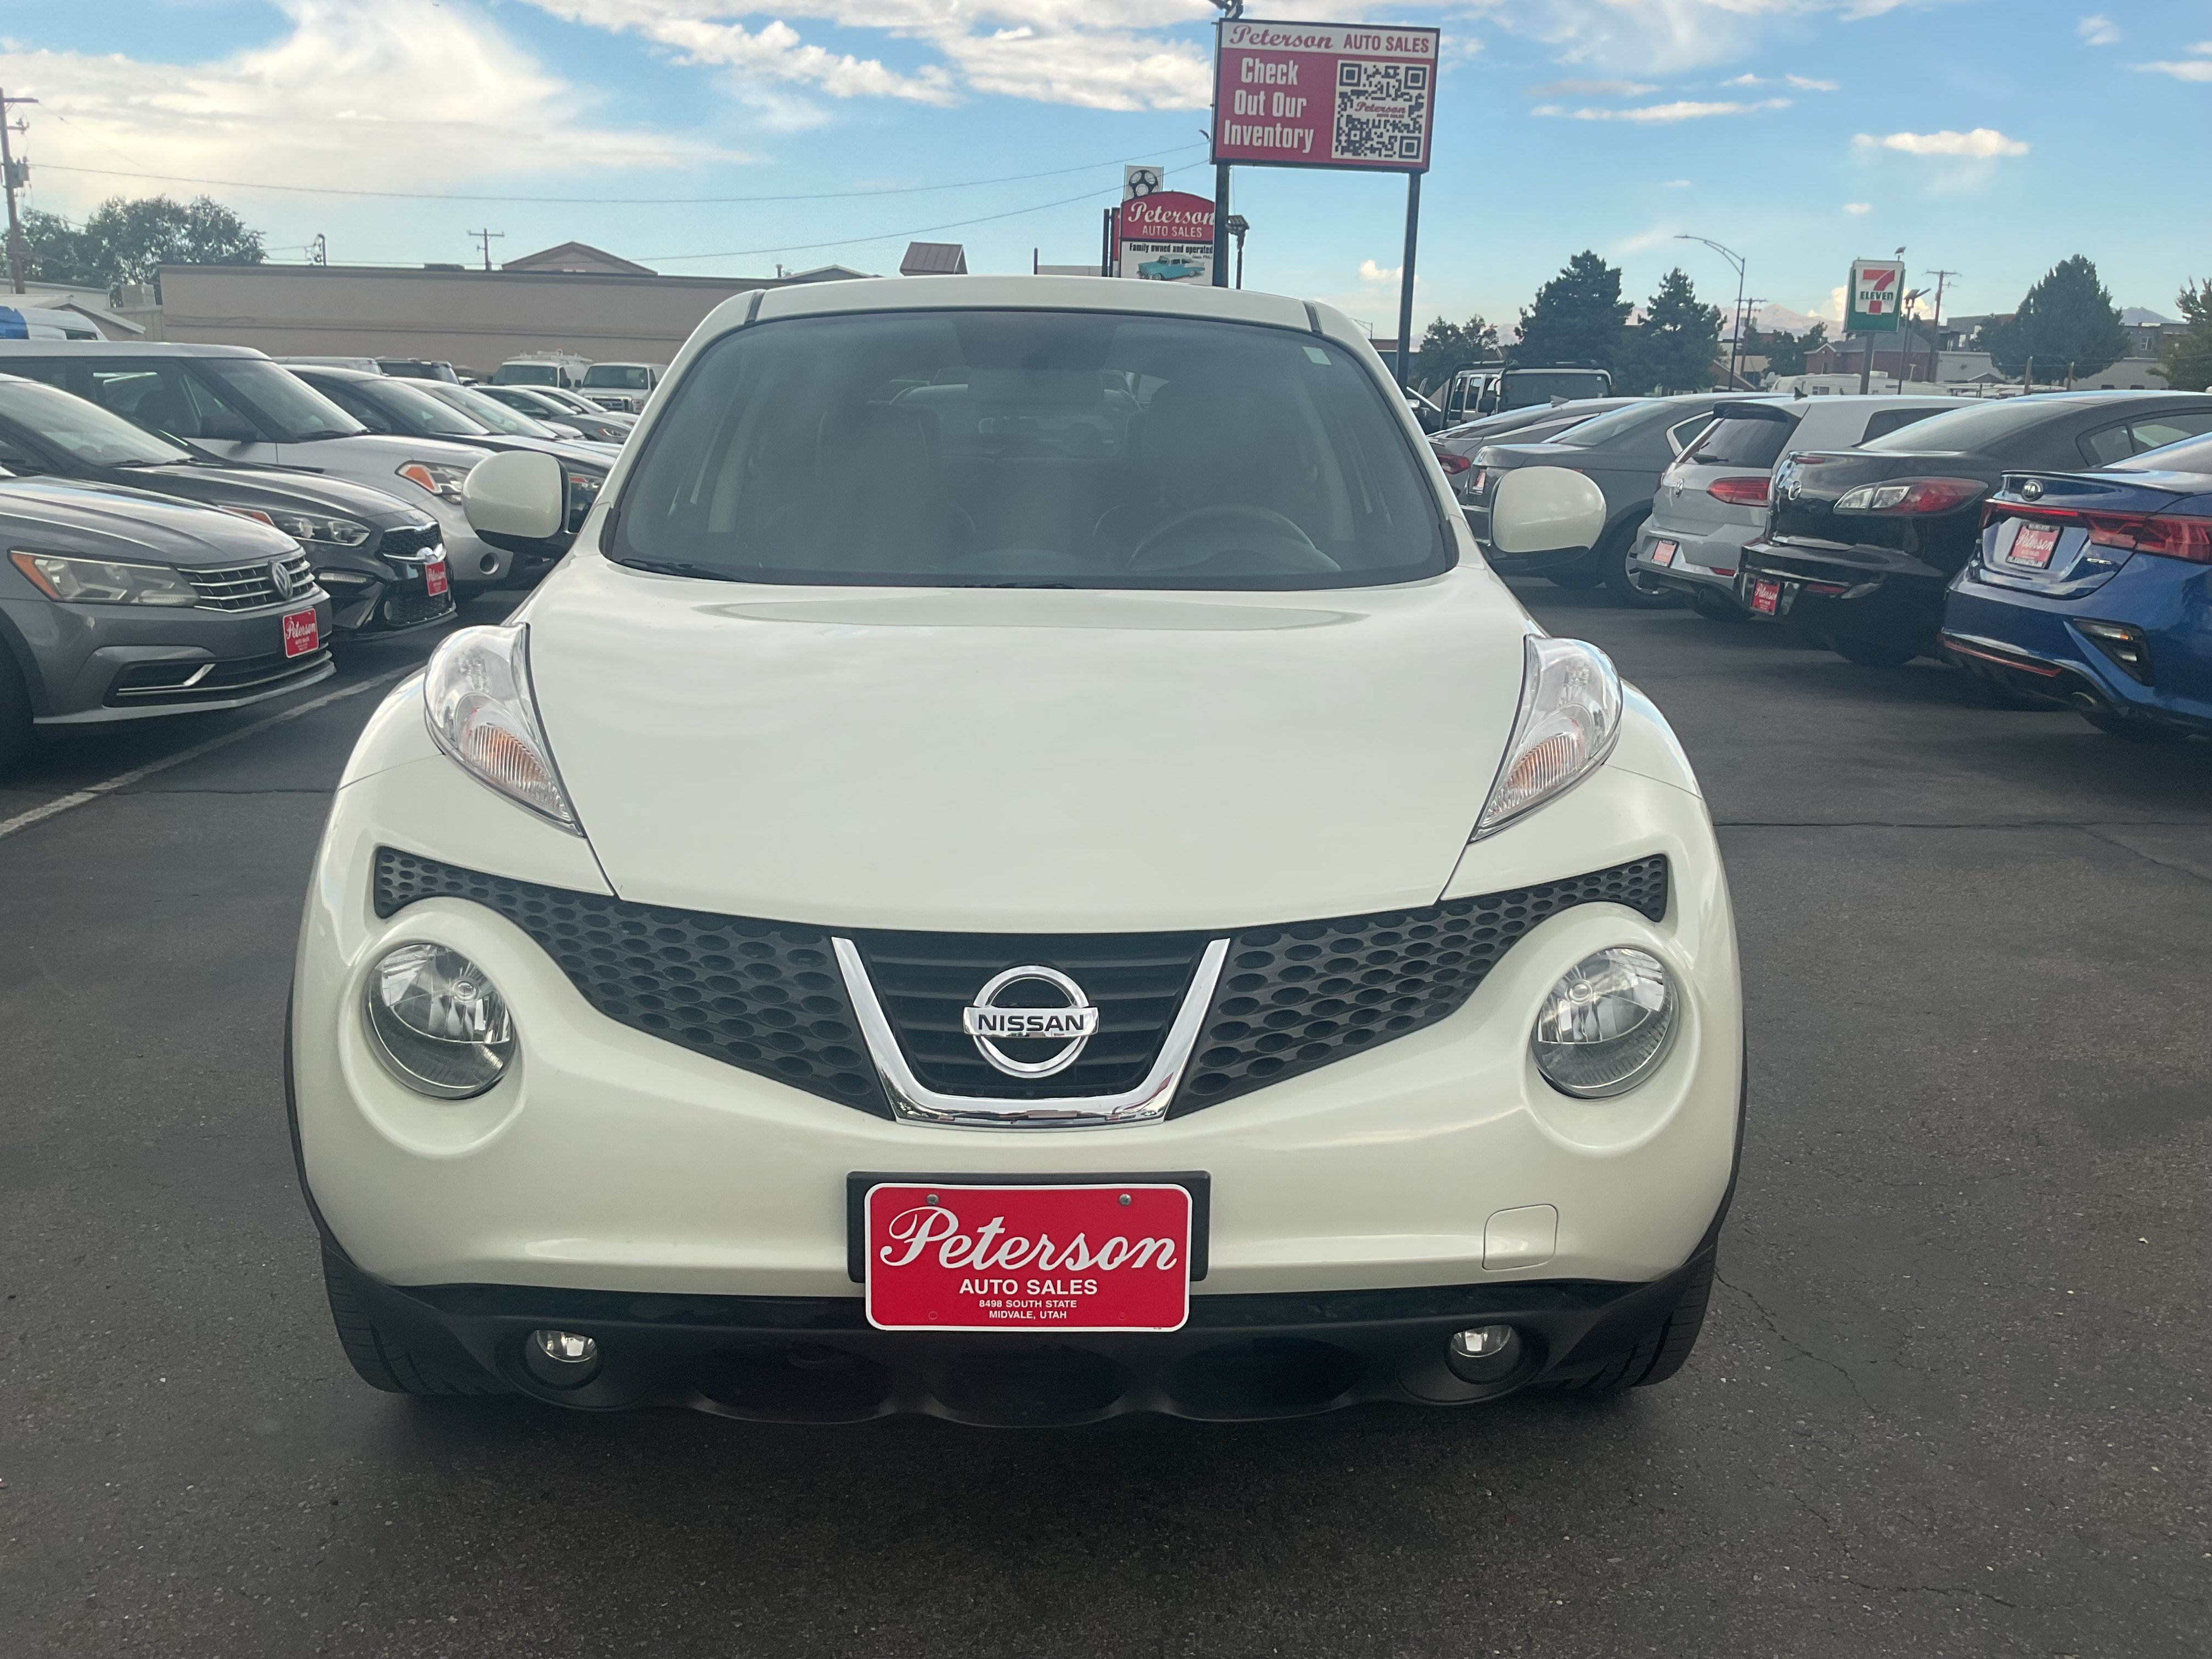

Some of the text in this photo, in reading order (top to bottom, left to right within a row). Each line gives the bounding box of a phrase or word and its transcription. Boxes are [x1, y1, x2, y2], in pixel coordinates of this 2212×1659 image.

[1229, 25, 1429, 53] Peterson AUTO SALES
[1240, 58, 1298, 85] Check
[1234, 90, 1307, 118] Out Our
[1224, 120, 1314, 154] Inventory
[1128, 202, 1215, 225] Peterson
[1142, 225, 1203, 238] AUTO SALES
[1130, 242, 1213, 255] Family owned and operated
[1863, 269, 1895, 313] 7
[2016, 530, 2054, 551] Peterson
[286, 620, 316, 640] Peterson
[978, 1014, 1084, 1031] NISSAN
[879, 1206, 1177, 1271] Peterson
[959, 1279, 1098, 1295] AUTO SALES
[1006, 1300, 1042, 1308] SOUTH
[1045, 1300, 1077, 1308] STATE
[989, 1310, 1067, 1320] MIDVALE, UTAH
